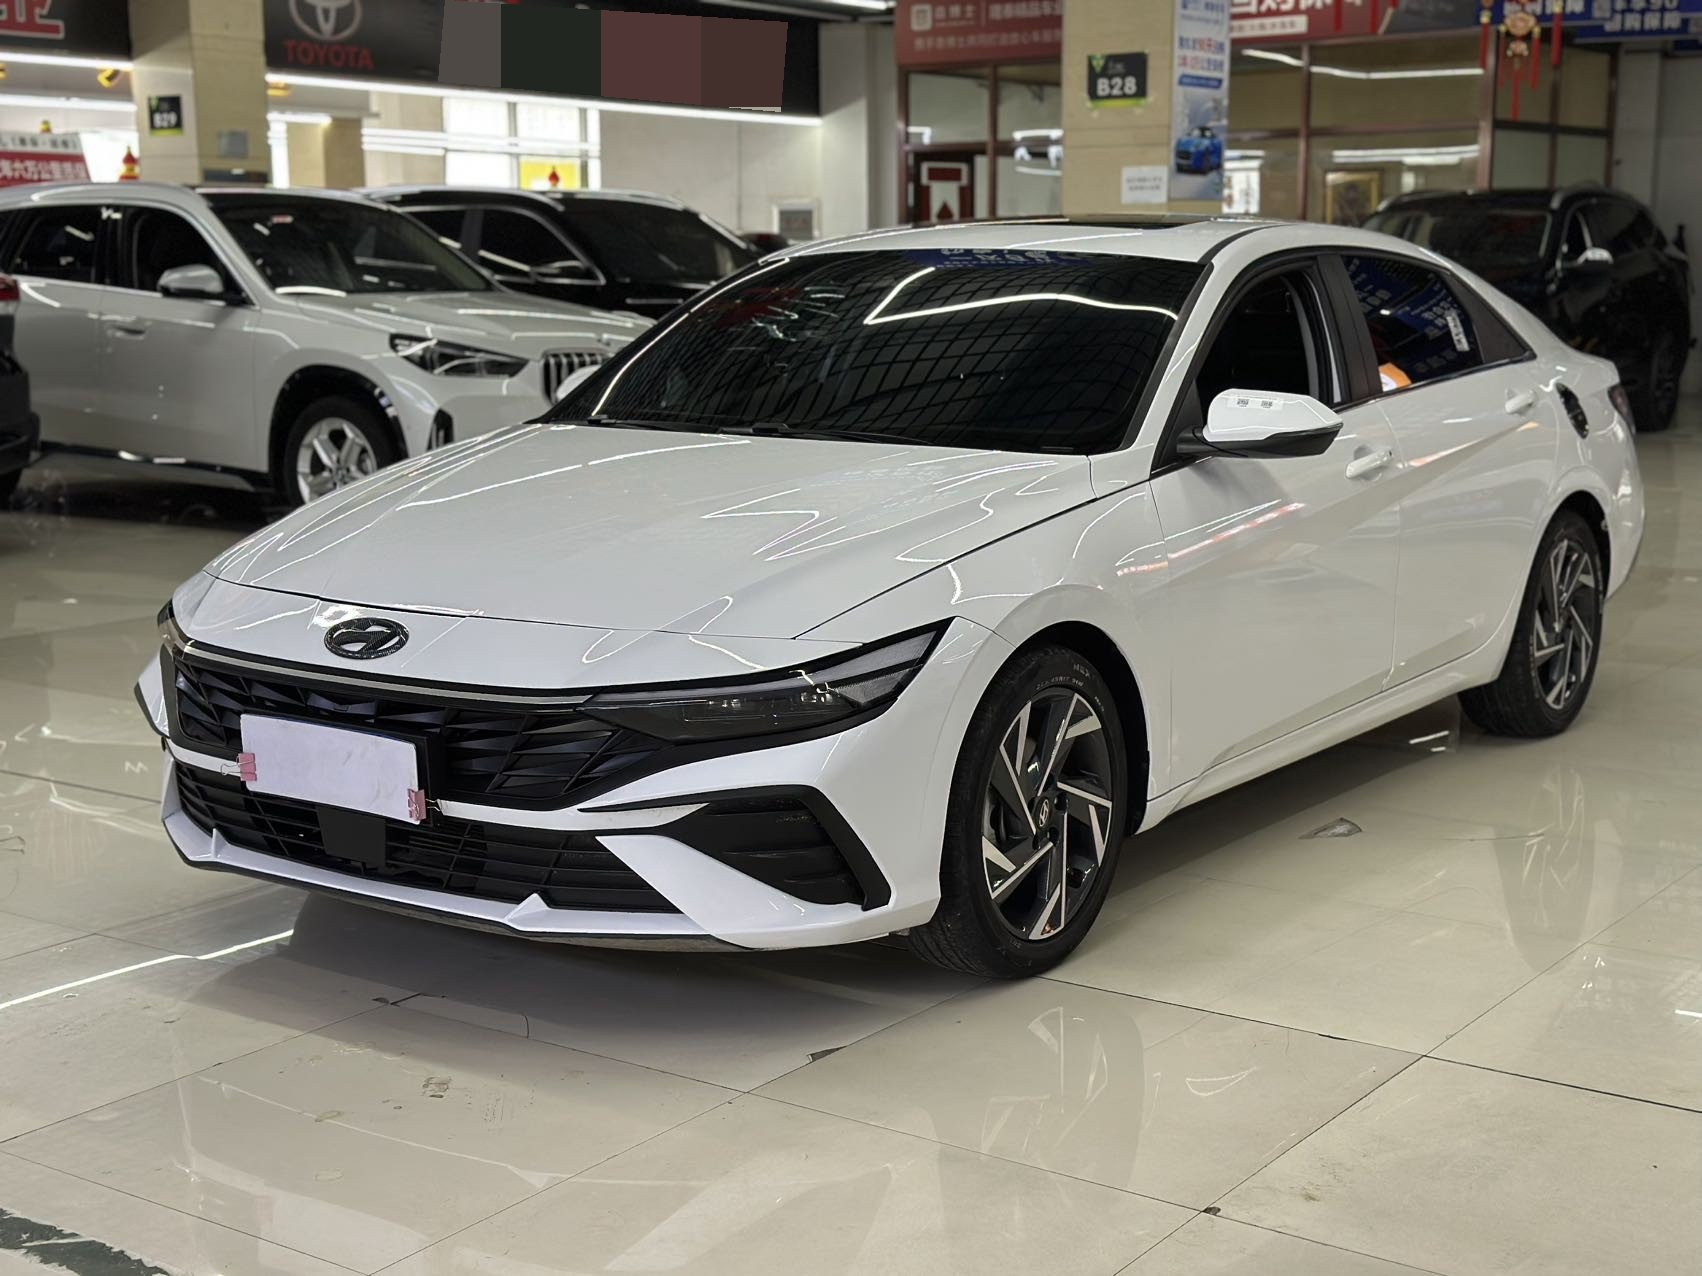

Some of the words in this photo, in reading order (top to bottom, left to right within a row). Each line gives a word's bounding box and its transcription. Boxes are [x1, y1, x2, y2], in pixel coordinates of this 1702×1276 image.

[283, 40, 374, 70] TOYOTA
[1097, 76, 1137, 96] B28
[153, 111, 177, 128] B29
